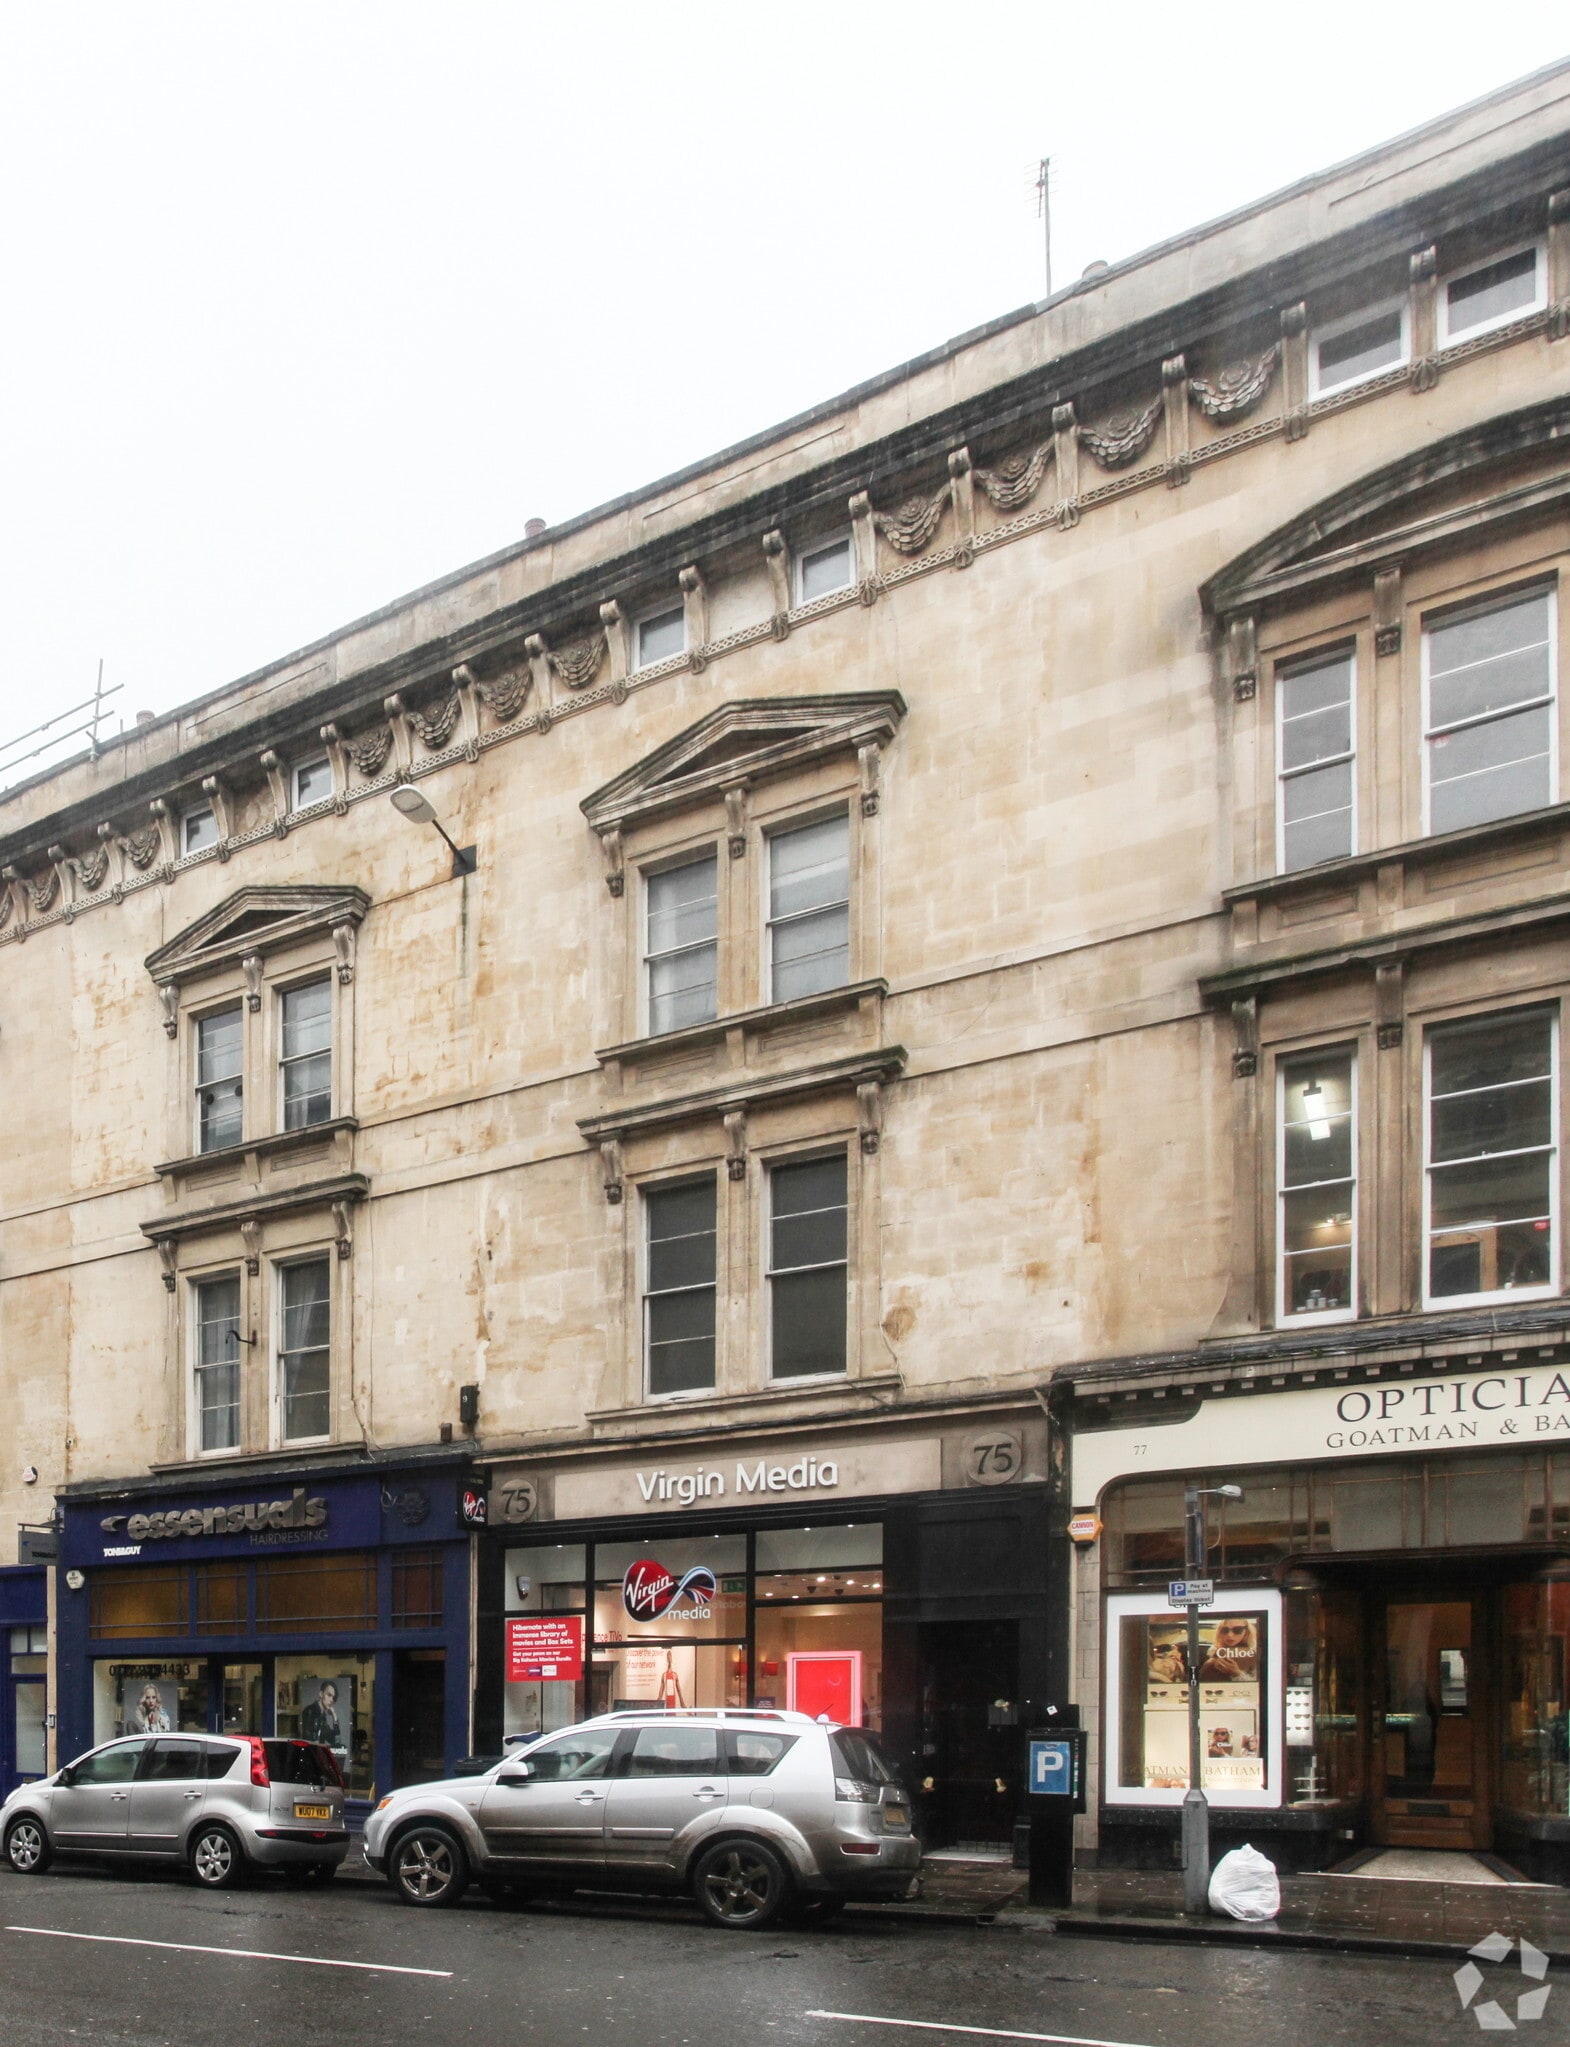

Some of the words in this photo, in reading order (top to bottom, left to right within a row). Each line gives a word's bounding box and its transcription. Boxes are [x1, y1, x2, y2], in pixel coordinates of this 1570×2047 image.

[1337, 1373, 1570, 1423] OPTICIA
[1326, 1421, 1479, 1449] GOATMAN
[1499, 1418, 1519, 1435] &
[1535, 1413, 1570, 1432] BA
[974, 1443, 1013, 1475] 75
[1133, 1445, 1147, 1456] 77
[636, 1466, 724, 1505] Virgin
[735, 1457, 838, 1493] Media
[126, 1487, 327, 1541] essensuals
[502, 1488, 531, 1515] 75
[250, 1529, 328, 1546] HAIRDRESSING
[1071, 1520, 1094, 1529] CANNON
[625, 1567, 674, 1612] Virgin
[668, 1606, 711, 1620] media
[1037, 1751, 1064, 1783] P
[1205, 1766, 1261, 1776] BATHAM
